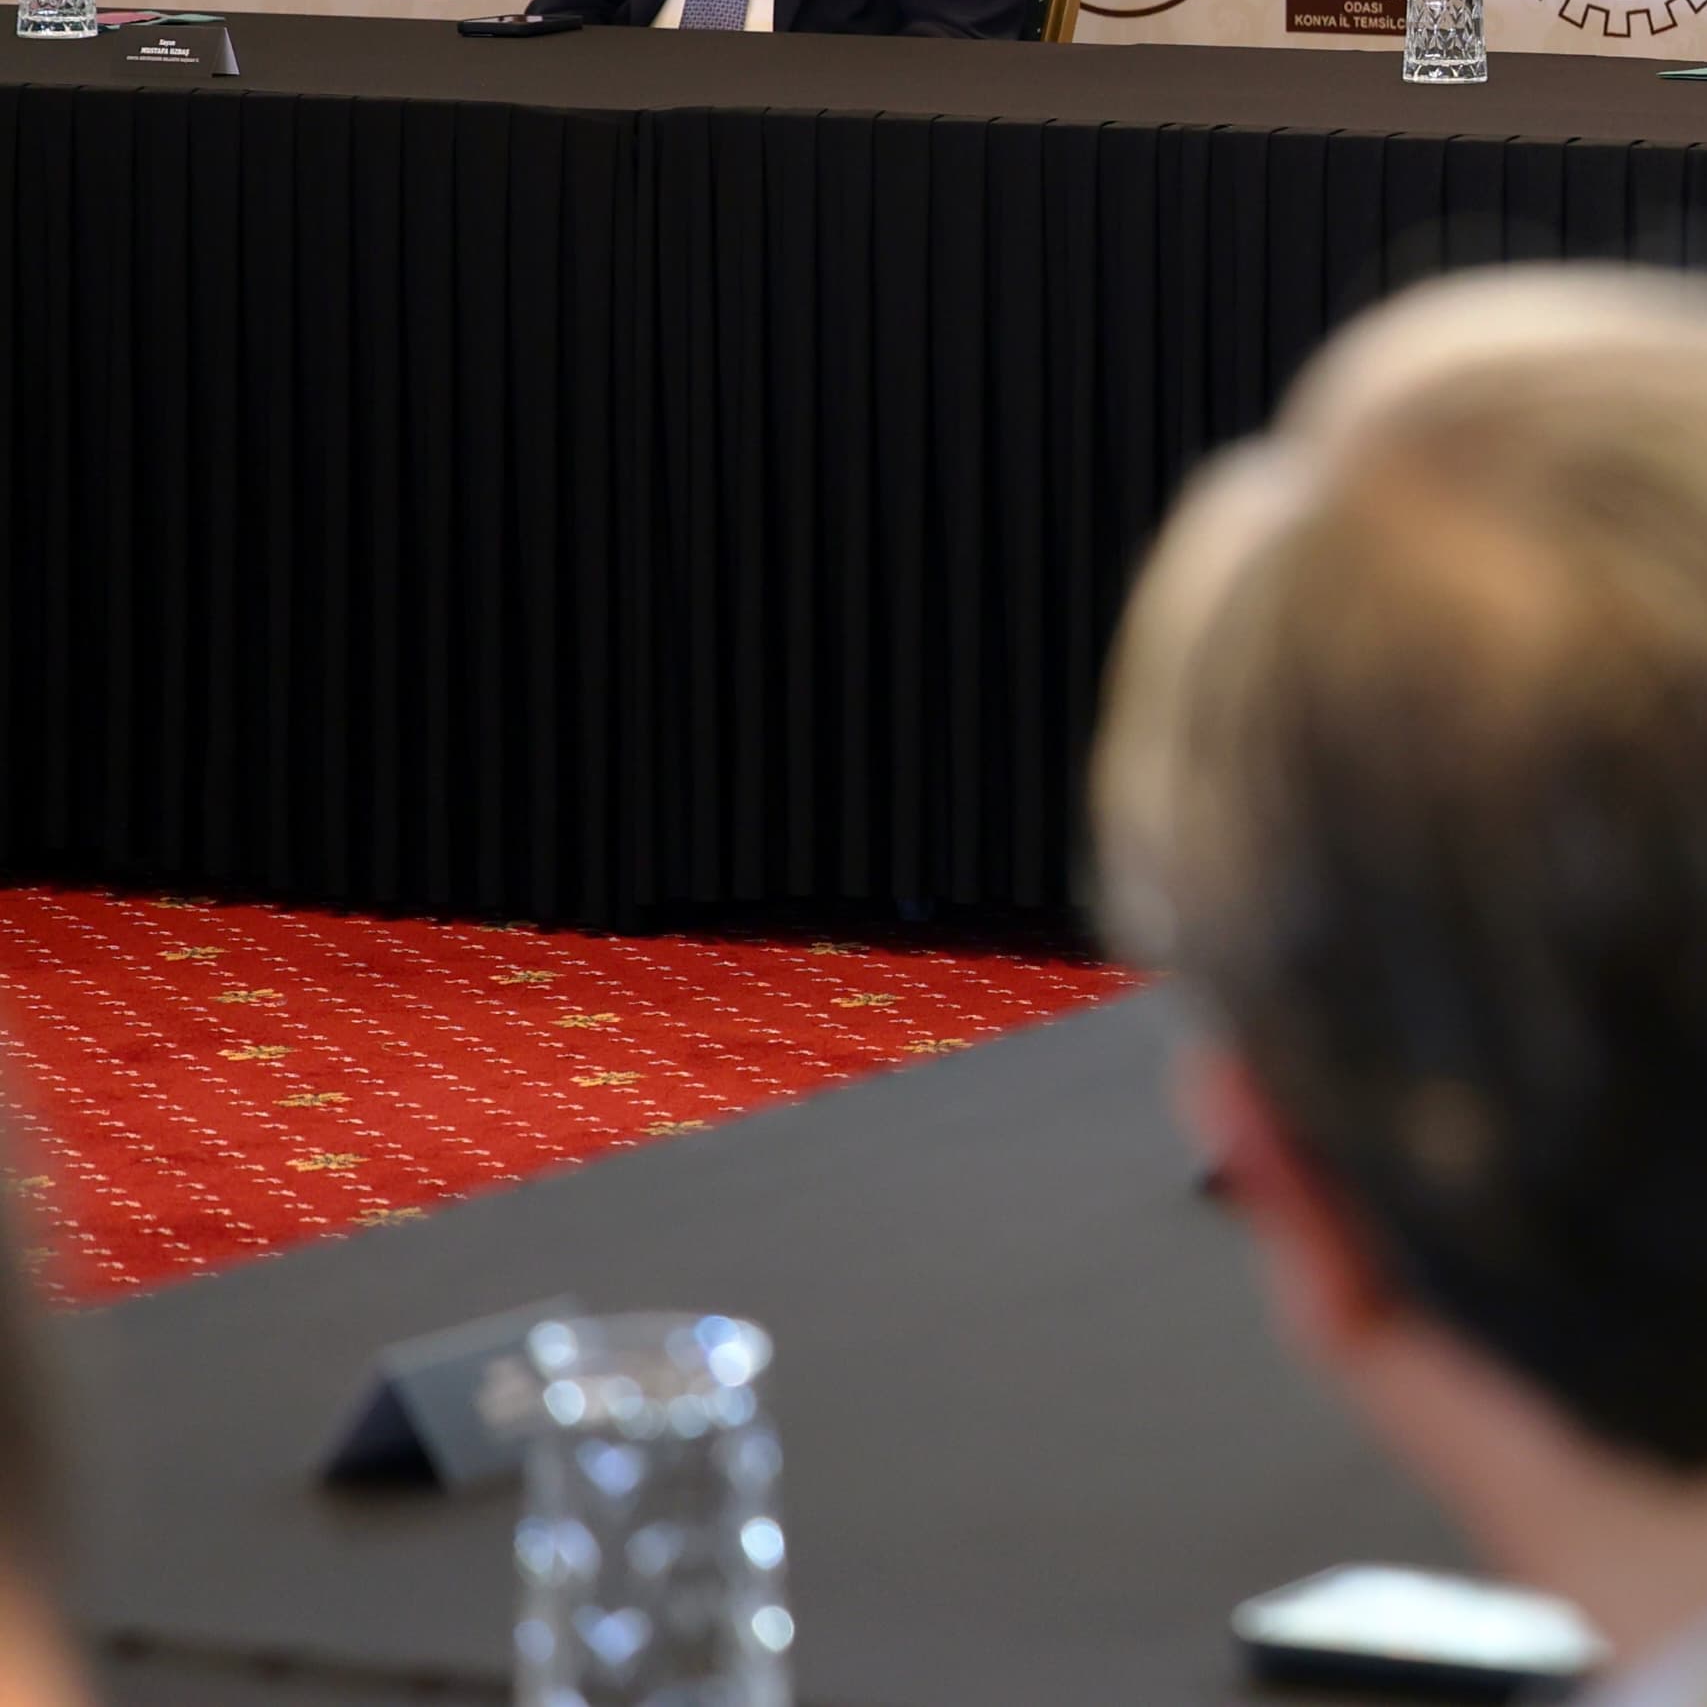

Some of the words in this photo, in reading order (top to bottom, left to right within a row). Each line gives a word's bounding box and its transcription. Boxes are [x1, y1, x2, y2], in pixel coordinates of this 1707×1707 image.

[1343, 1, 1383, 14] ODASI
[1294, 14, 1337, 27] KONYA
[1339, 14, 1350, 28] İL
[1353, 15, 1406, 30] TEMSİLC
